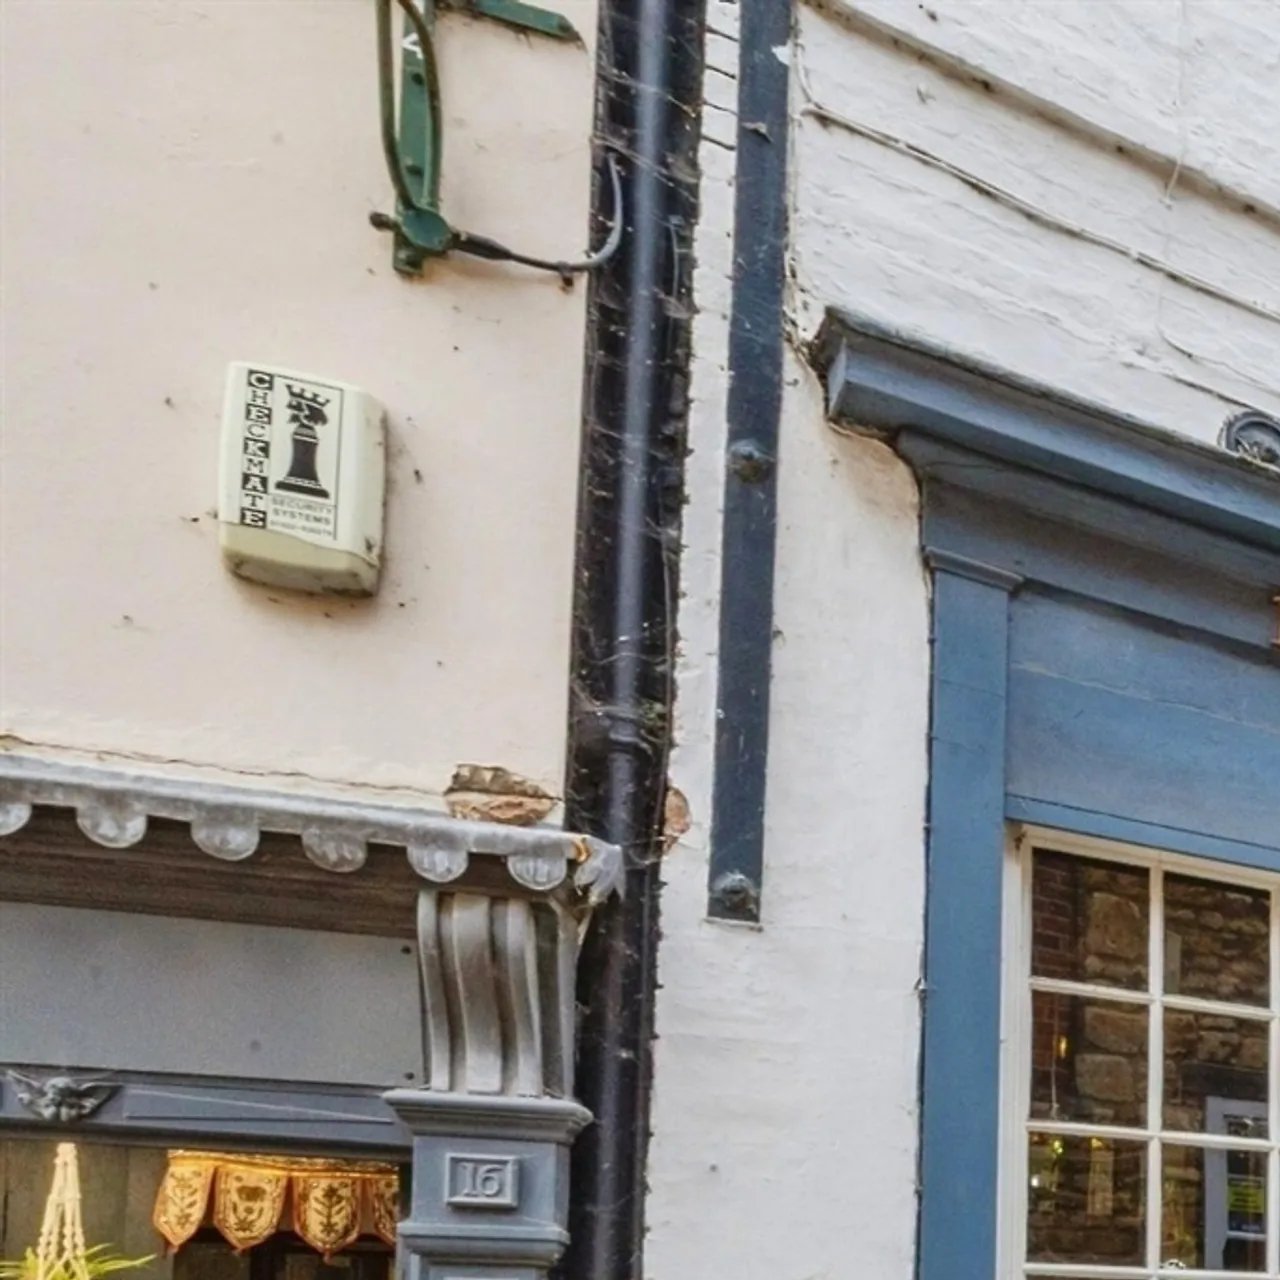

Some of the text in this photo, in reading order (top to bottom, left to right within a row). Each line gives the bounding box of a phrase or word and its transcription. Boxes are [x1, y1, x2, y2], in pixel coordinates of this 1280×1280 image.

[240, 369, 273, 529] CHECKMATE
[271, 497, 333, 516] SECURITY
[273, 508, 332, 526] SYSTEMS
[460, 1162, 505, 1198] 16
